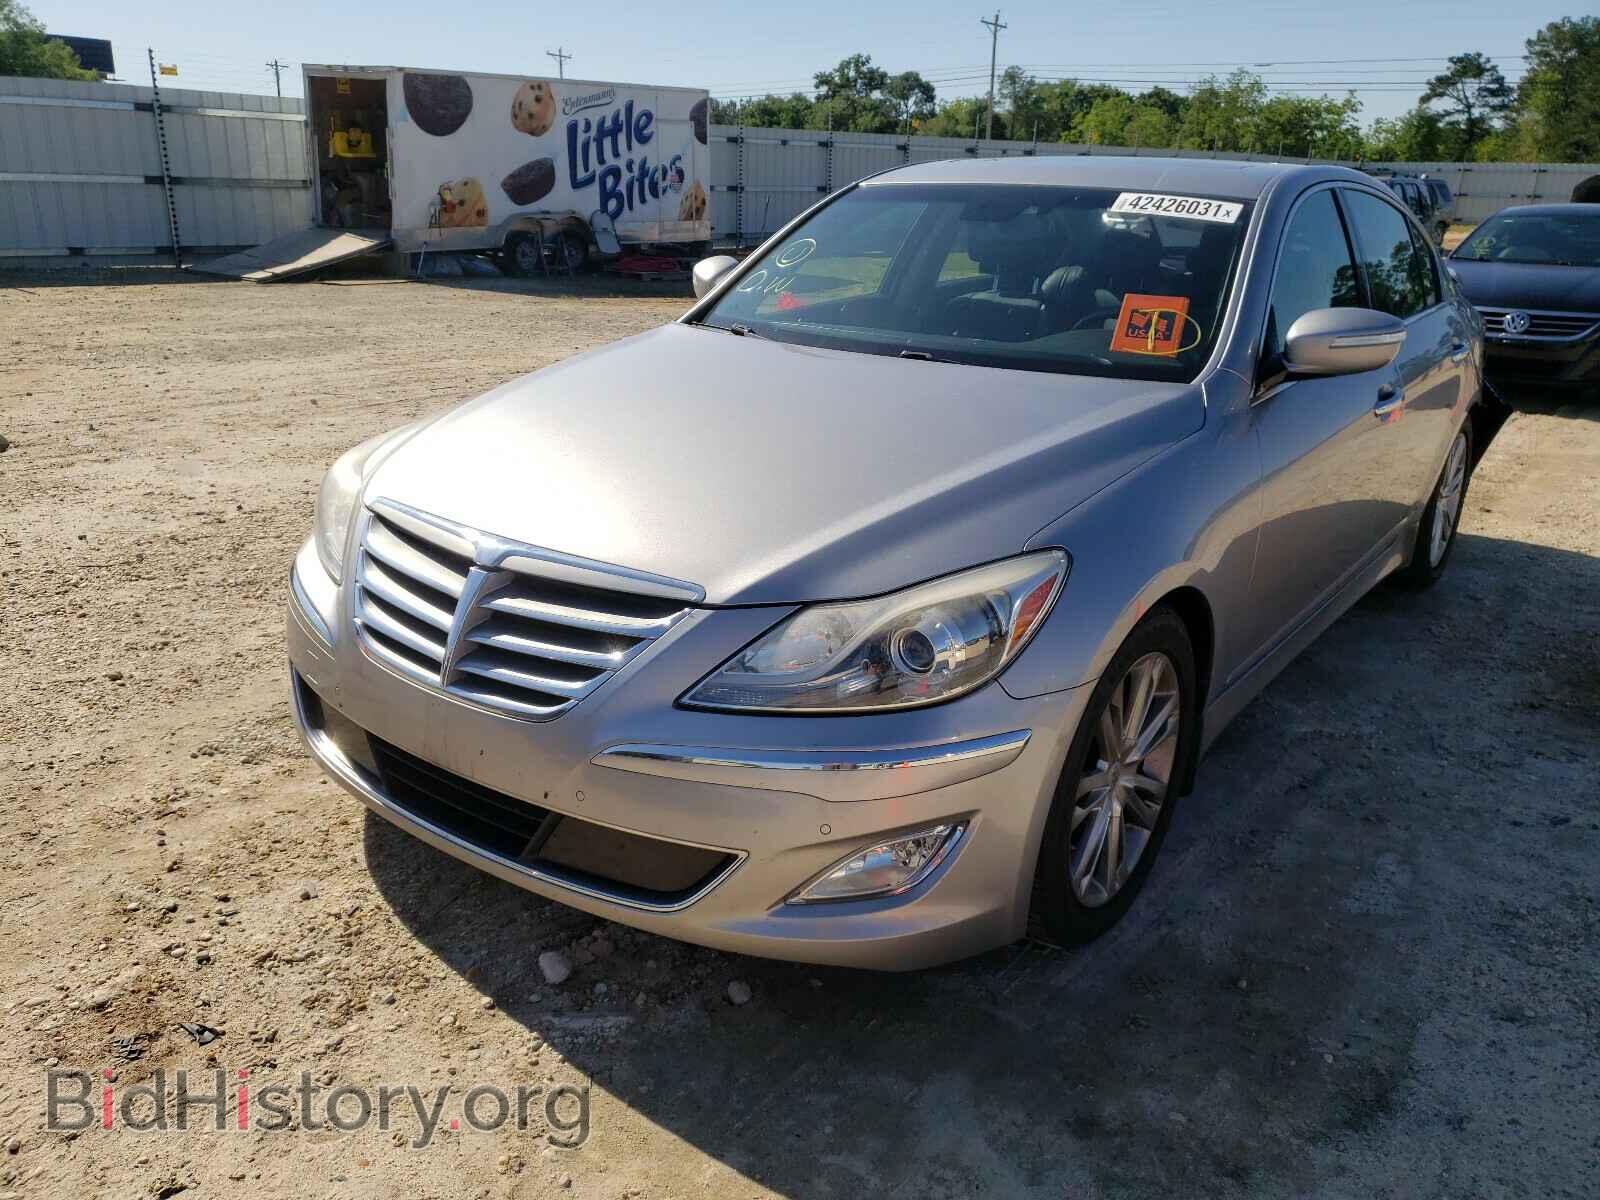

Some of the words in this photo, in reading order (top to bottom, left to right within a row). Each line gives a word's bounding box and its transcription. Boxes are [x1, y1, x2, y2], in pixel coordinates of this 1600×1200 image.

[567, 100, 654, 189] Little
[599, 156, 685, 220] Bites
[1129, 195, 1222, 217] 42426031
